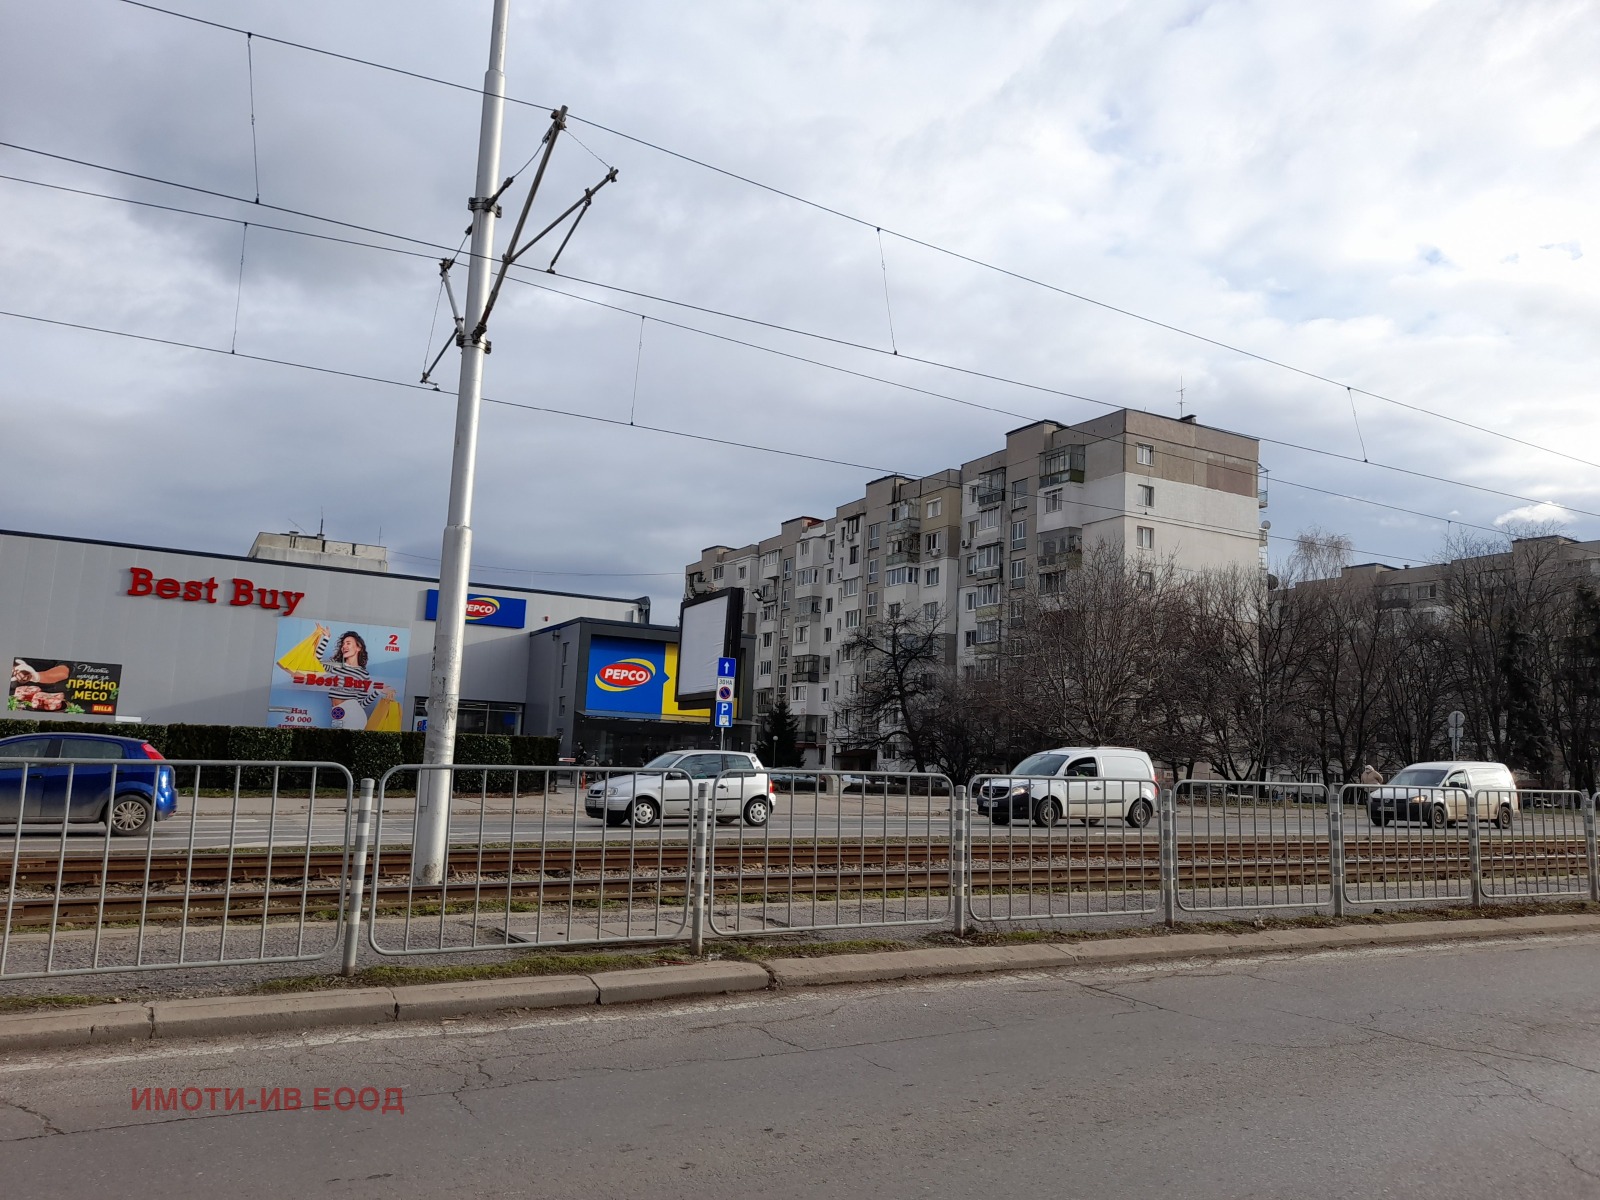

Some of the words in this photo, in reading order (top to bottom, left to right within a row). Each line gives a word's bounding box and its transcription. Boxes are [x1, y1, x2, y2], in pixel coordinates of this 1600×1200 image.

[127, 567, 218, 604] Best
[230, 578, 305, 616] Buy
[388, 634, 399, 646] 2
[604, 668, 647, 682] PEPCO
[67, 678, 117, 691] ПРЯСНО
[305, 673, 340, 687] Best
[343, 676, 373, 692] Buy
[74, 690, 108, 702] МЕСО
[721, 703, 729, 715] P
[284, 715, 295, 723] 50
